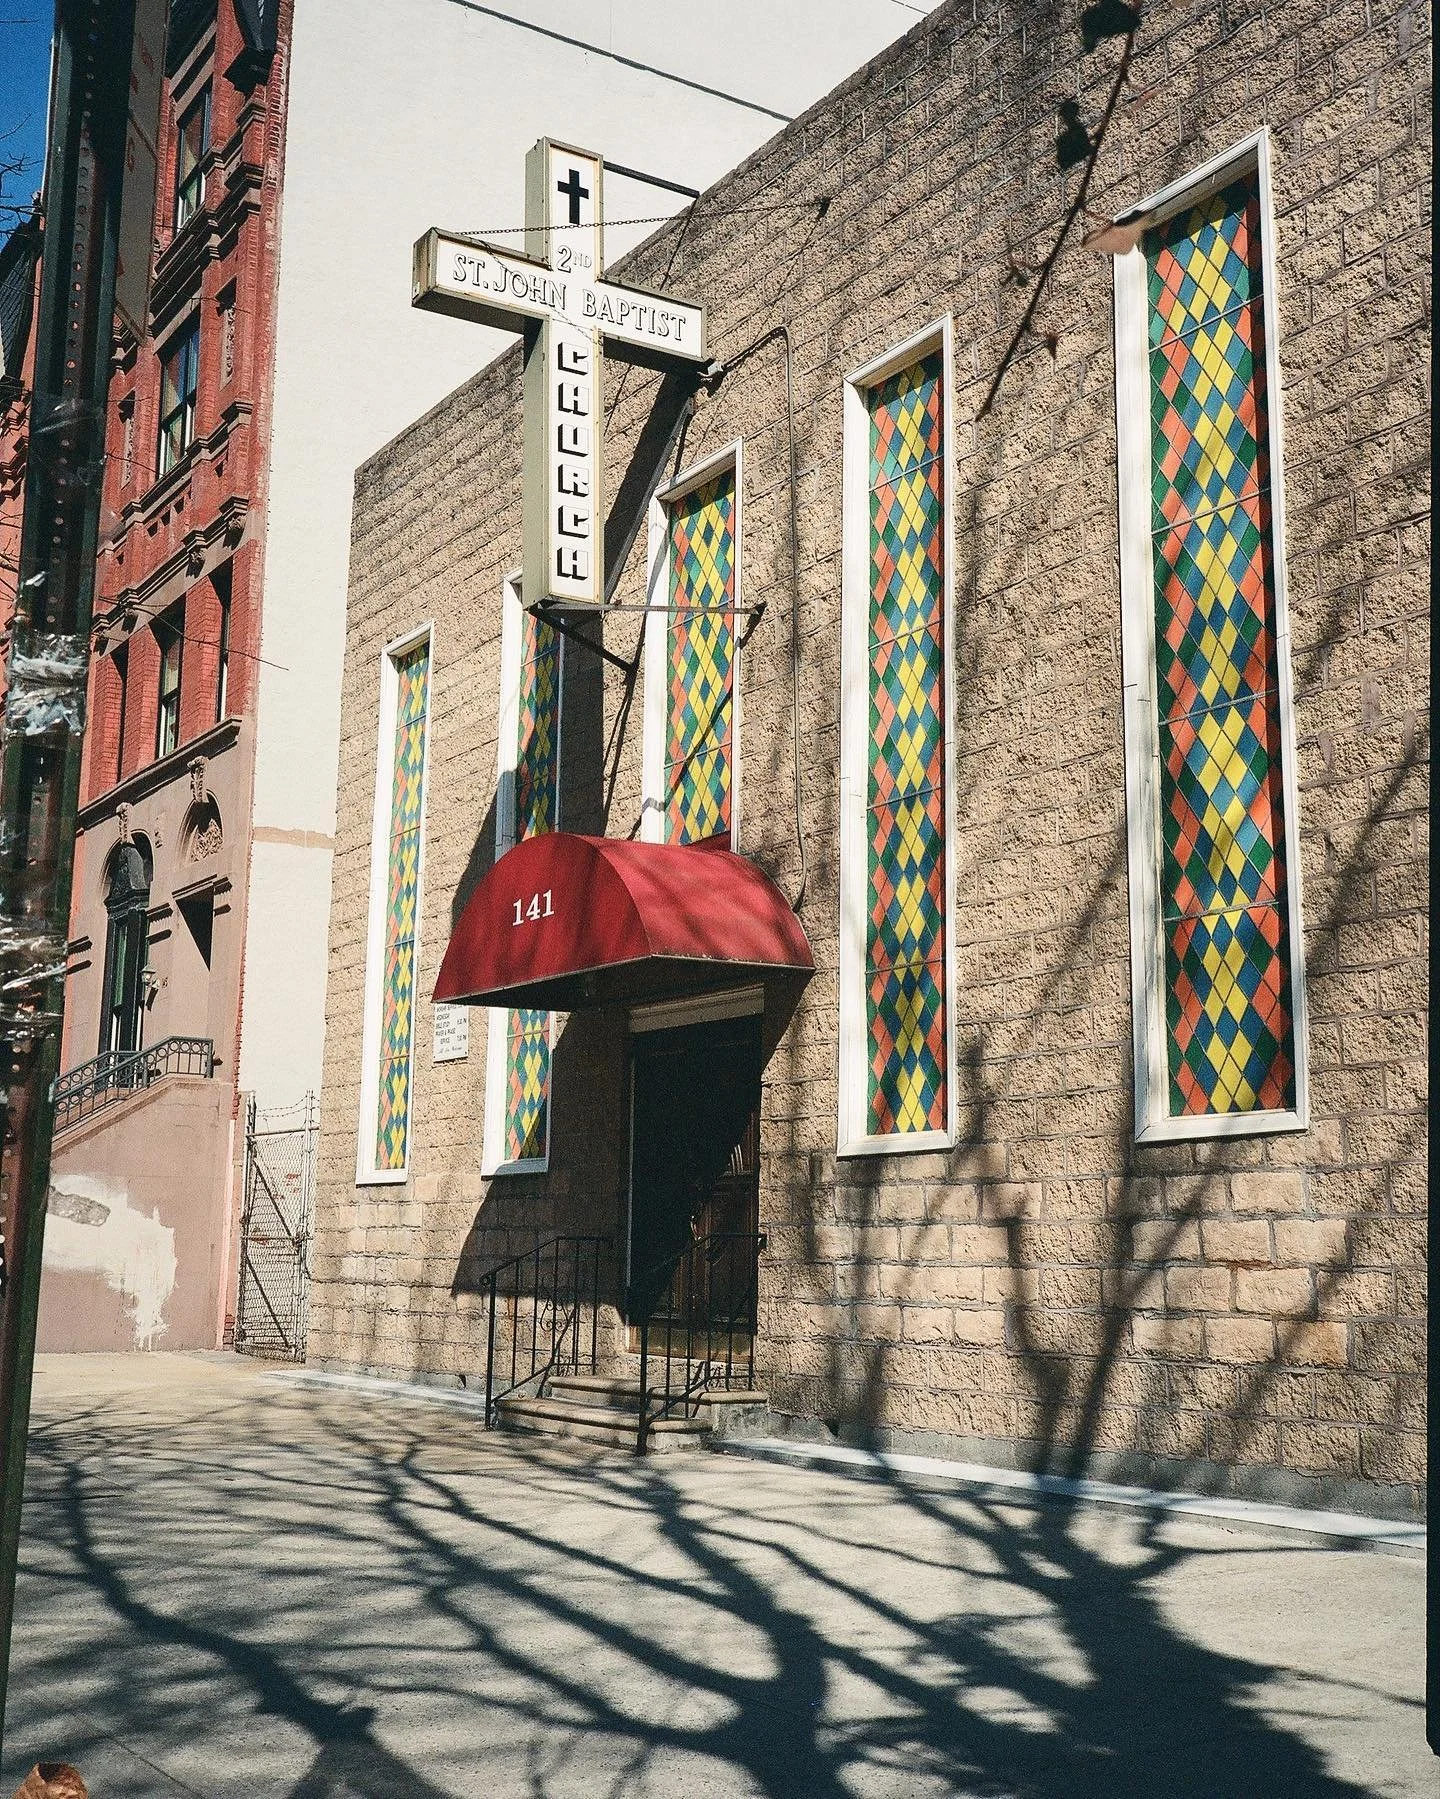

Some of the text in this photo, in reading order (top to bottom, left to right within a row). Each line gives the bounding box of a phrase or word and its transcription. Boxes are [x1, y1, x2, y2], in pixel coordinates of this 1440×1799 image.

[556, 244, 592, 273] 2ND
[452, 253, 687, 342] ST. JOHN BAPTIST
[557, 341, 590, 582] CHURCH
[512, 889, 555, 926] 141
